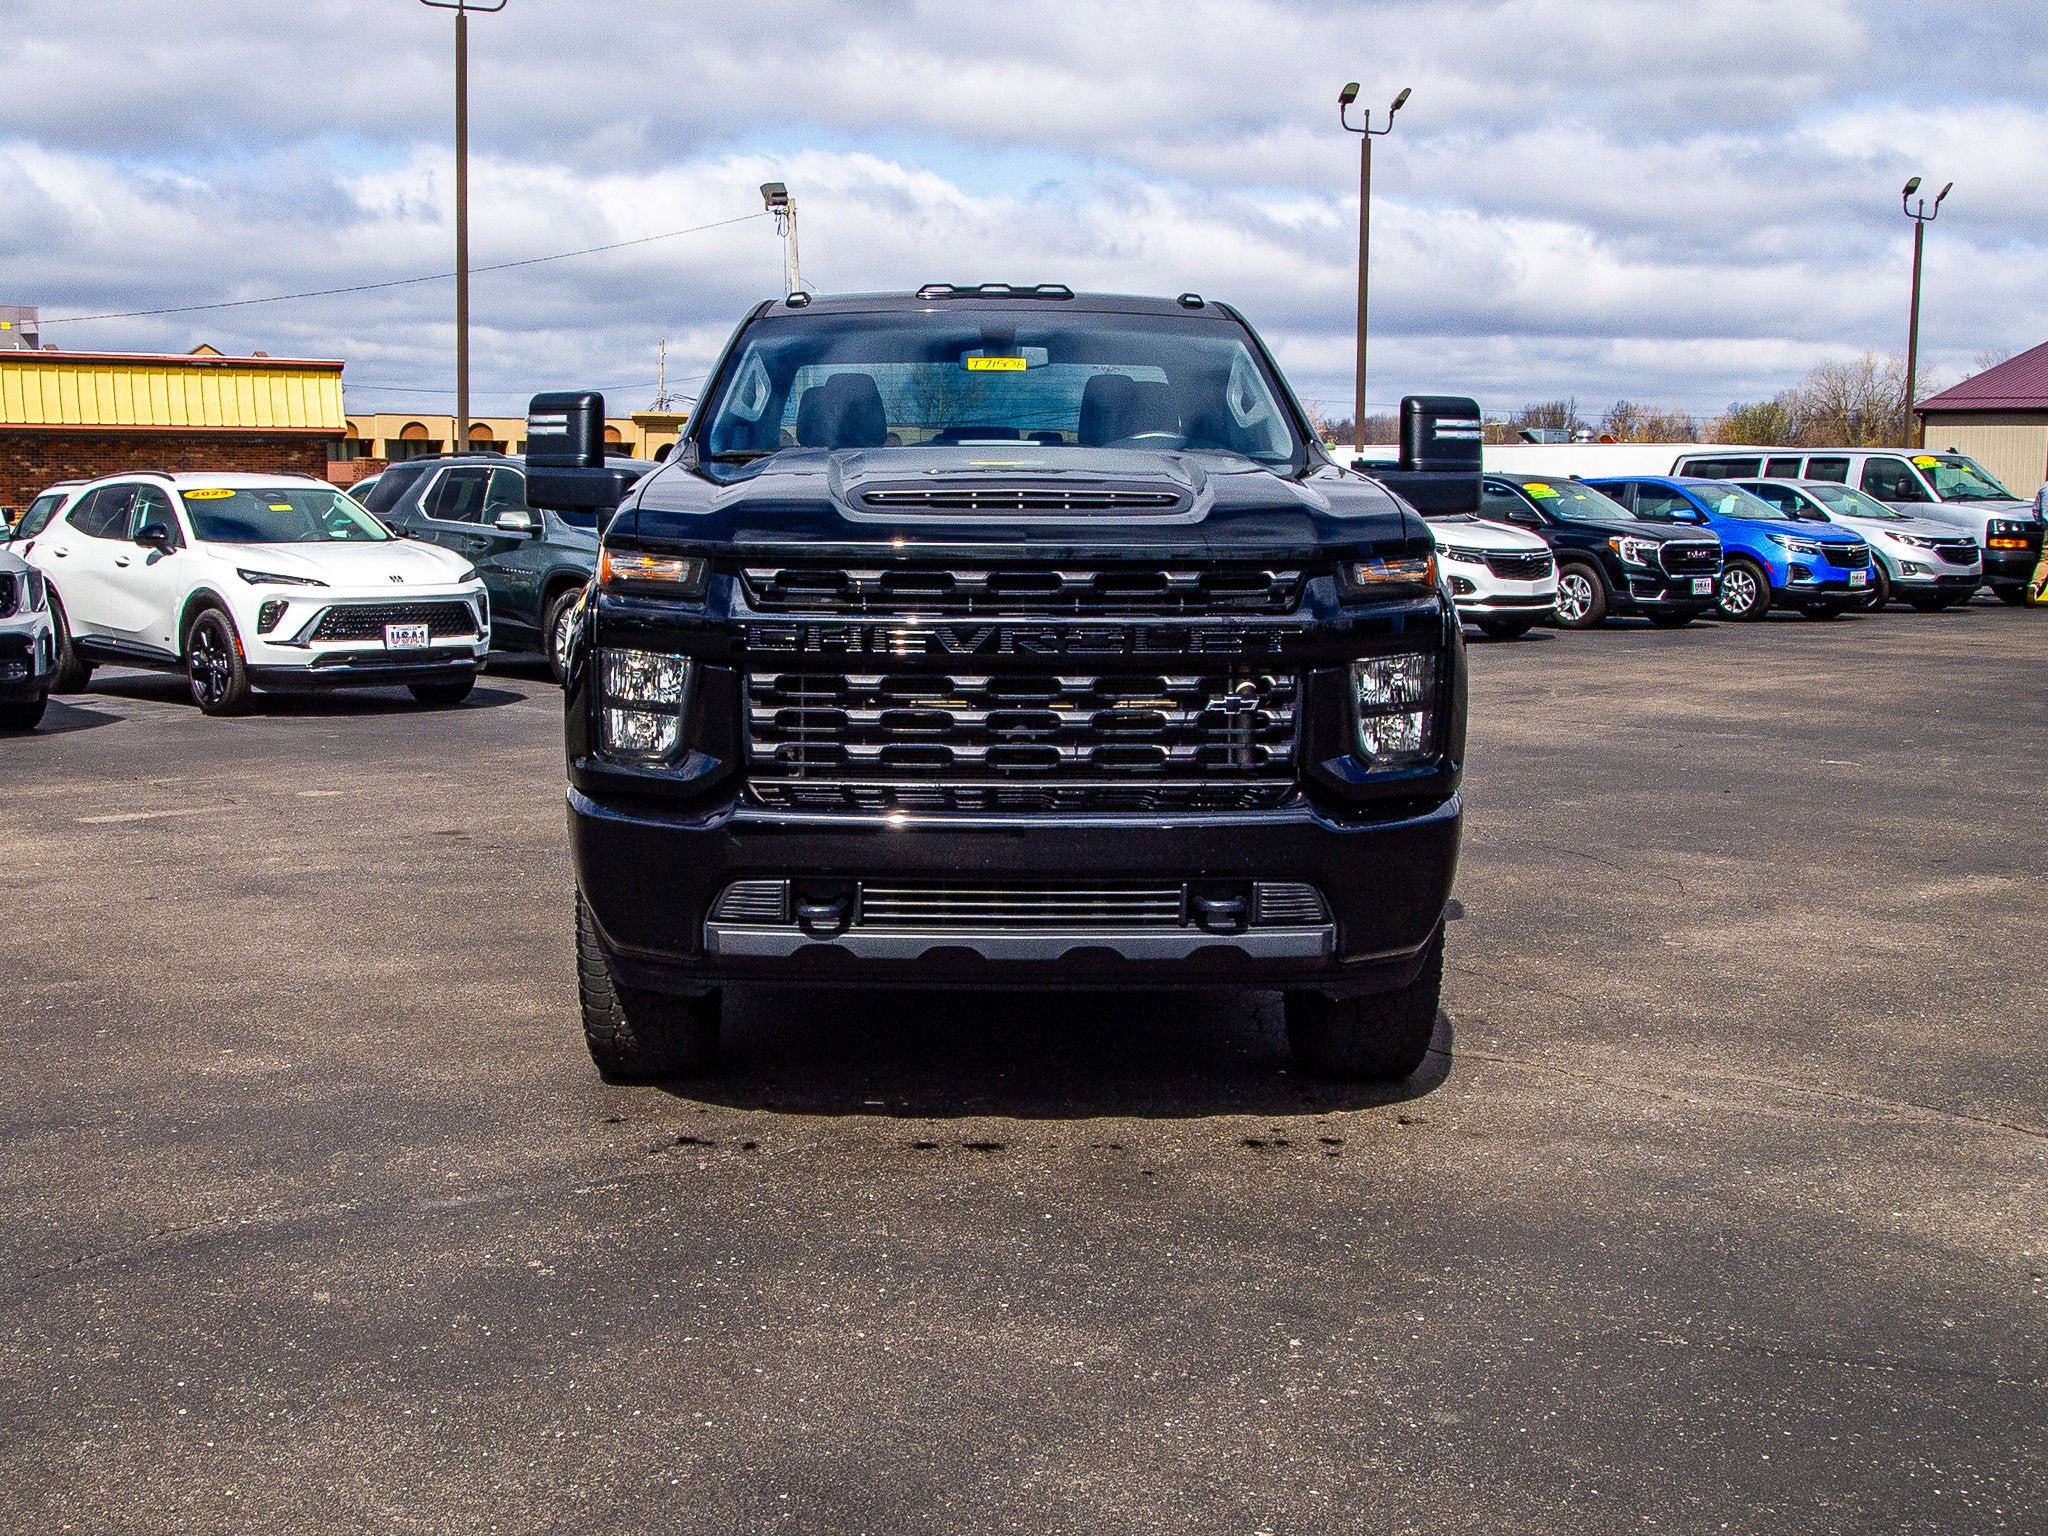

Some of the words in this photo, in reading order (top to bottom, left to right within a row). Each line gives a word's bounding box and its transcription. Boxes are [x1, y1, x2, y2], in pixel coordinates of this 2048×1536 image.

[192, 490, 229, 498] 2025
[390, 630, 425, 645] USA1
[747, 625, 1303, 654] CHEVROLET
